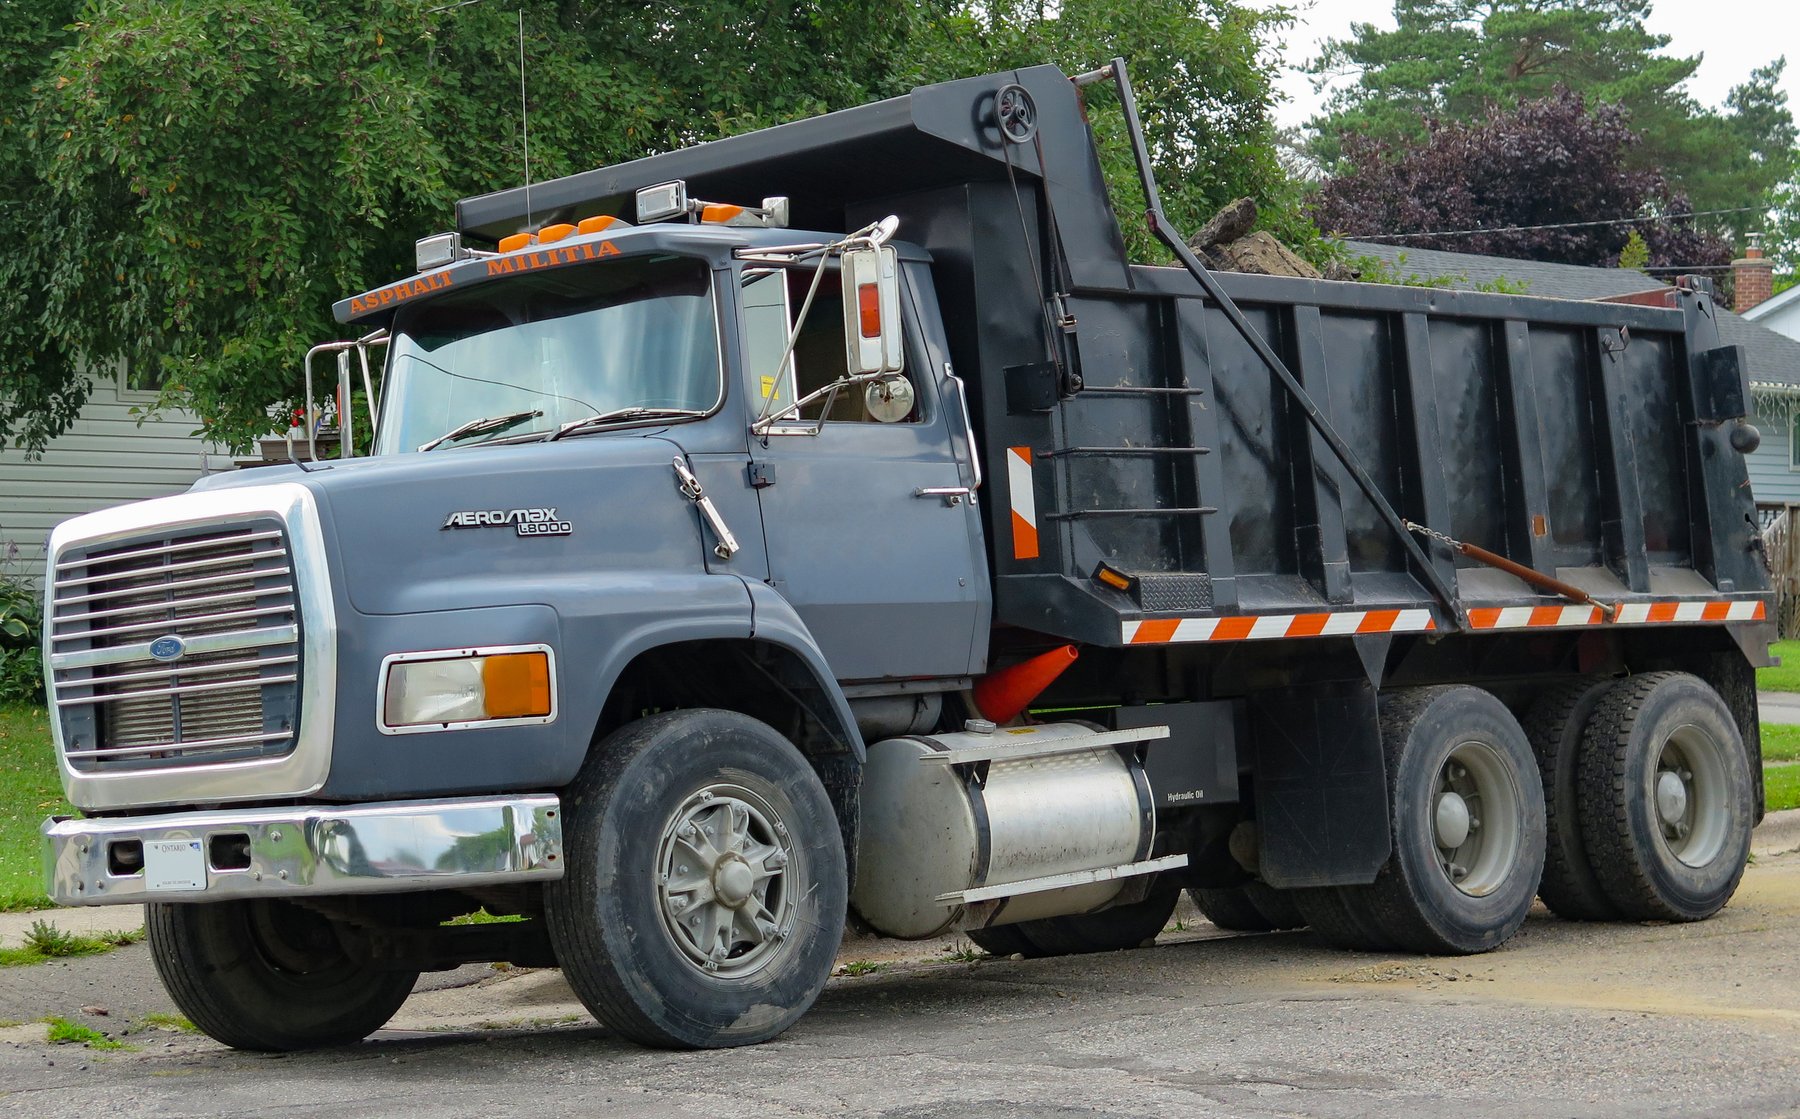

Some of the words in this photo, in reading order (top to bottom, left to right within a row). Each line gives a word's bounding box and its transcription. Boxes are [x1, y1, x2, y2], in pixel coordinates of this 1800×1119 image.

[351, 271, 452, 314] ASPHALT
[487, 240, 621, 276] MILITIA
[1167, 791, 1194, 802] Hydraulic
[1195, 790, 1204, 799] Oil
